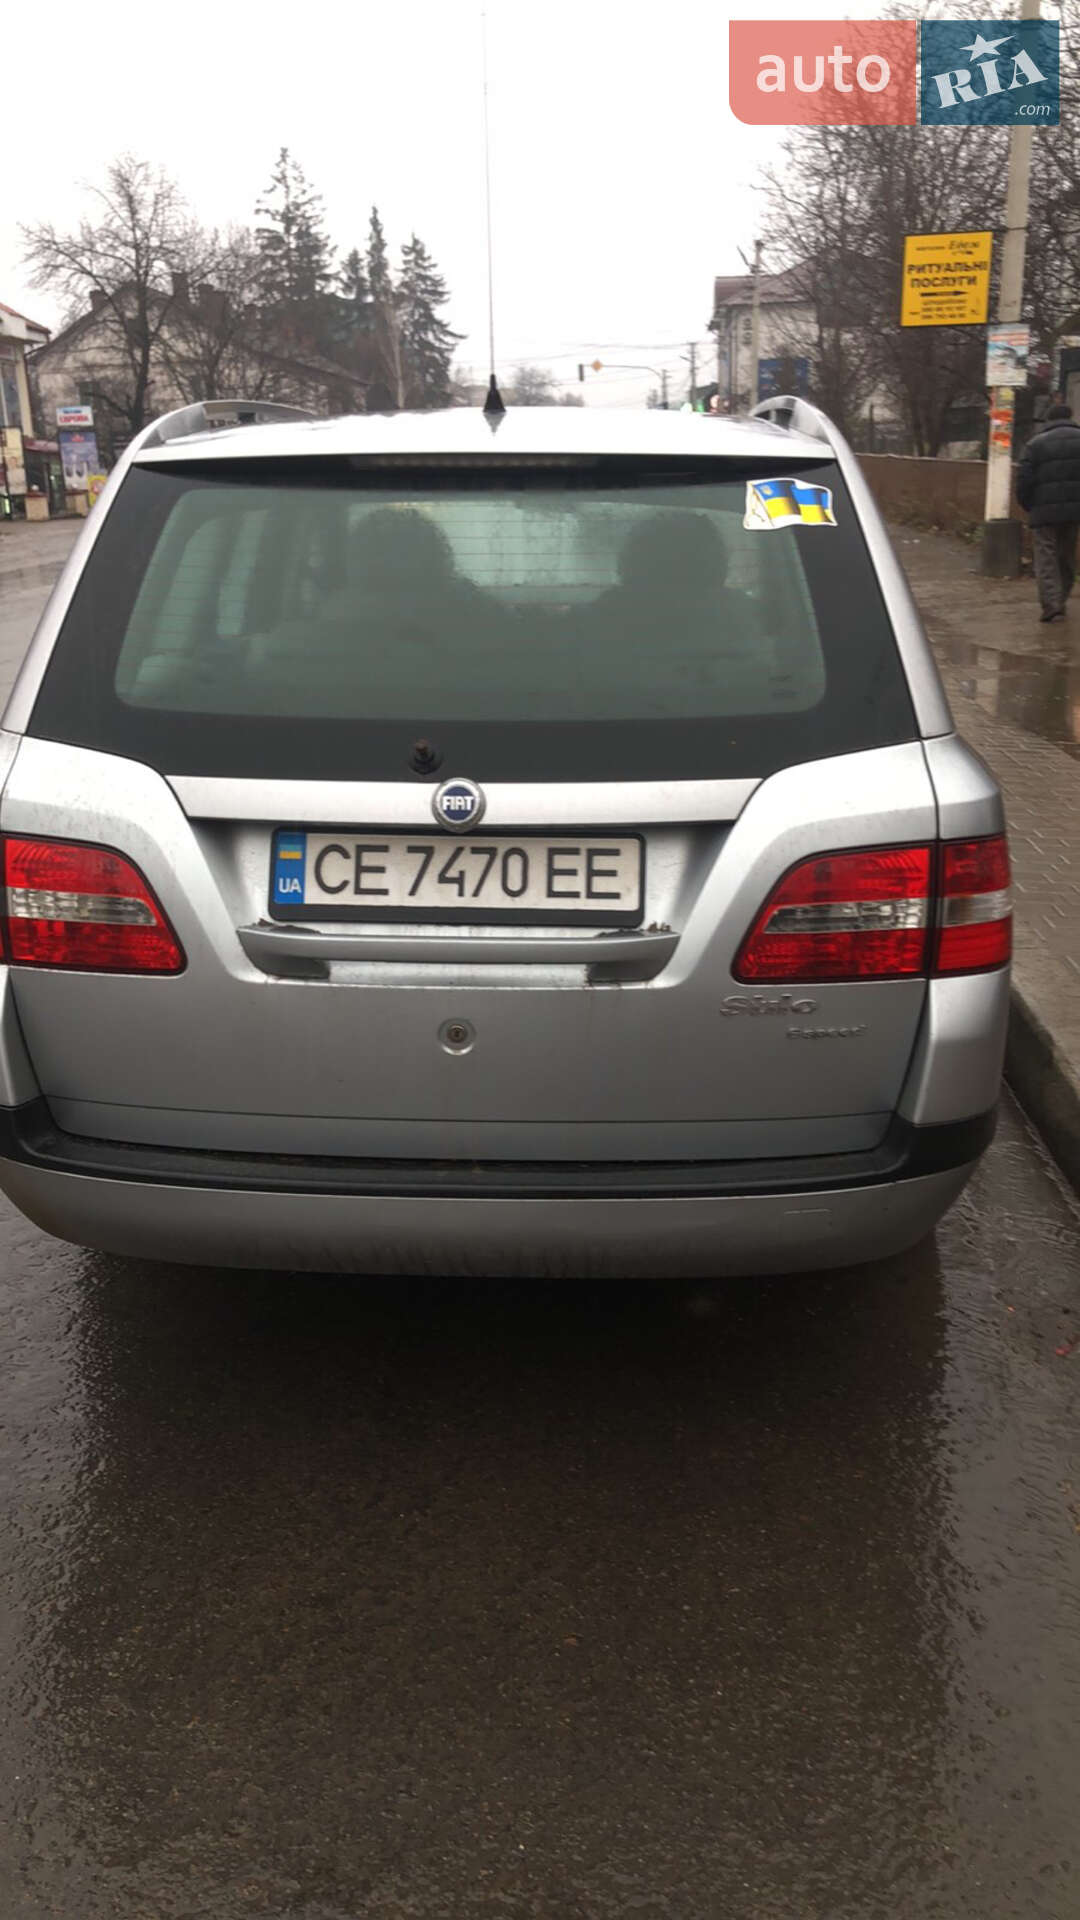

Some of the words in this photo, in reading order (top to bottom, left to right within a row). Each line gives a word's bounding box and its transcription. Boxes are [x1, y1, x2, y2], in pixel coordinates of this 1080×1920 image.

[907, 261, 988, 275] РИТУАЛЬНІ
[911, 276, 977, 288] ПОСЛУГИ
[442, 796, 475, 811] FIAT
[406, 846, 530, 898] 7470
[278, 878, 302, 893] UA
